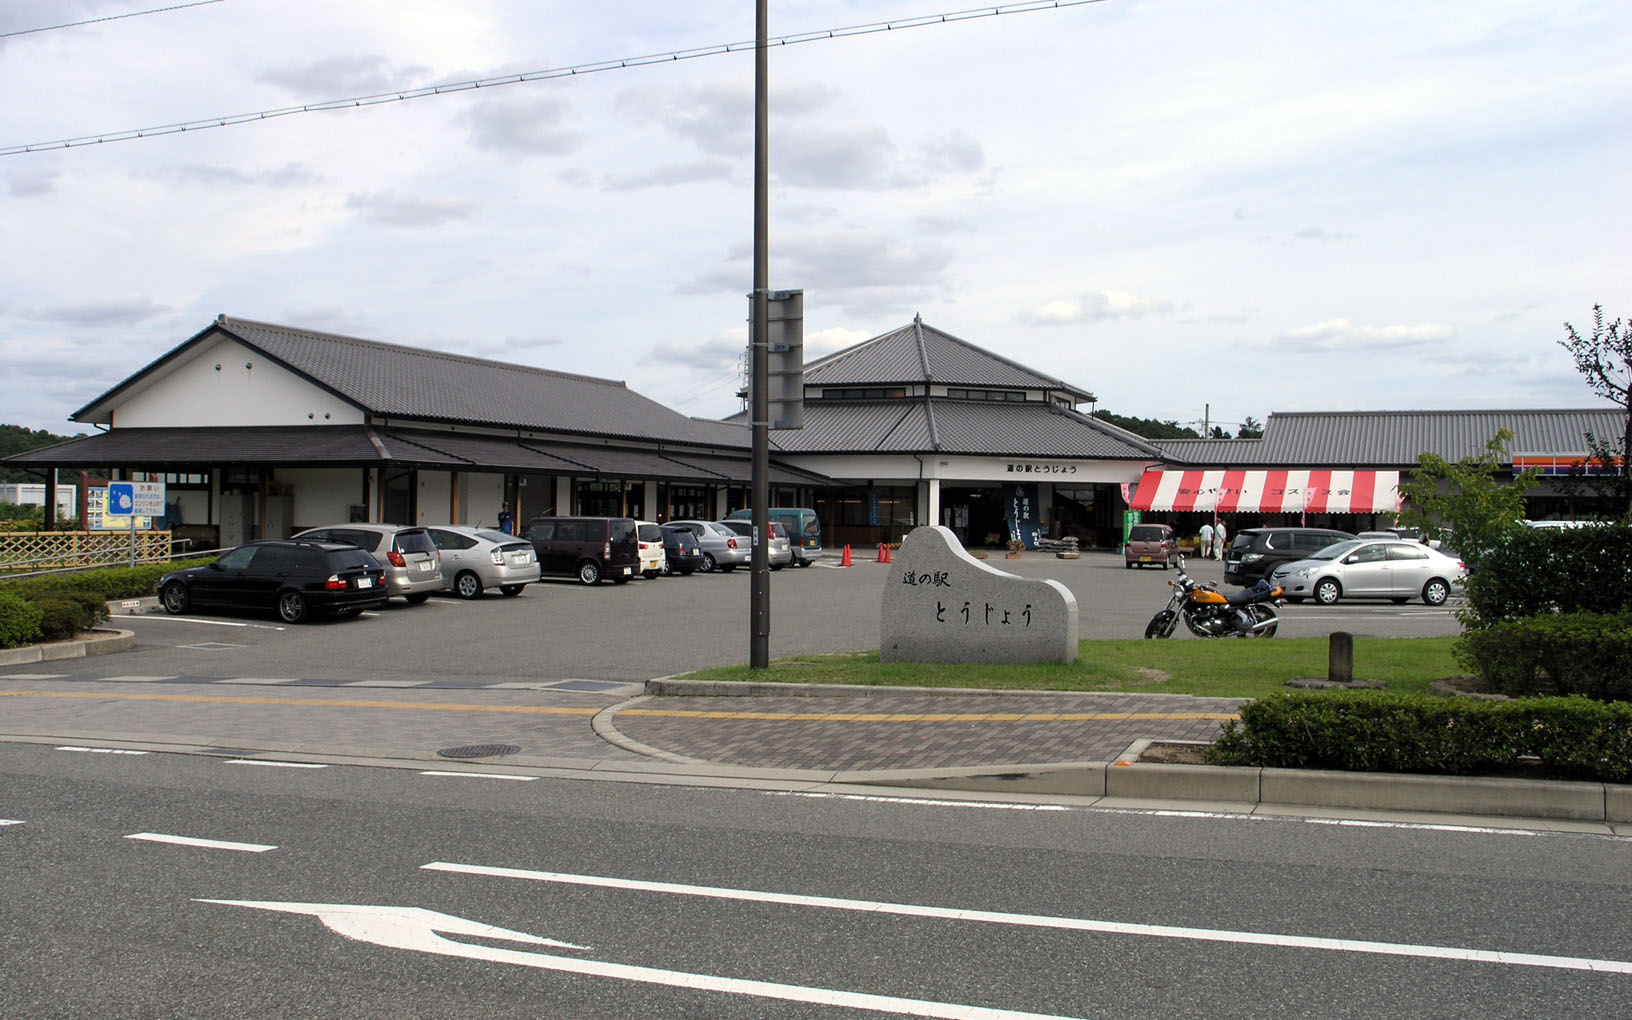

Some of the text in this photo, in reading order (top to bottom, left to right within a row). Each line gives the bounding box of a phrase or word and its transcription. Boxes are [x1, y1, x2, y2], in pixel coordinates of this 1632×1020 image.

[1006, 464, 1077, 474] 道の駅とうじょう
[1022, 497, 1030, 520] 道の駅
[902, 570, 951, 587] 道の駅
[936, 600, 1032, 628] とうじょう
